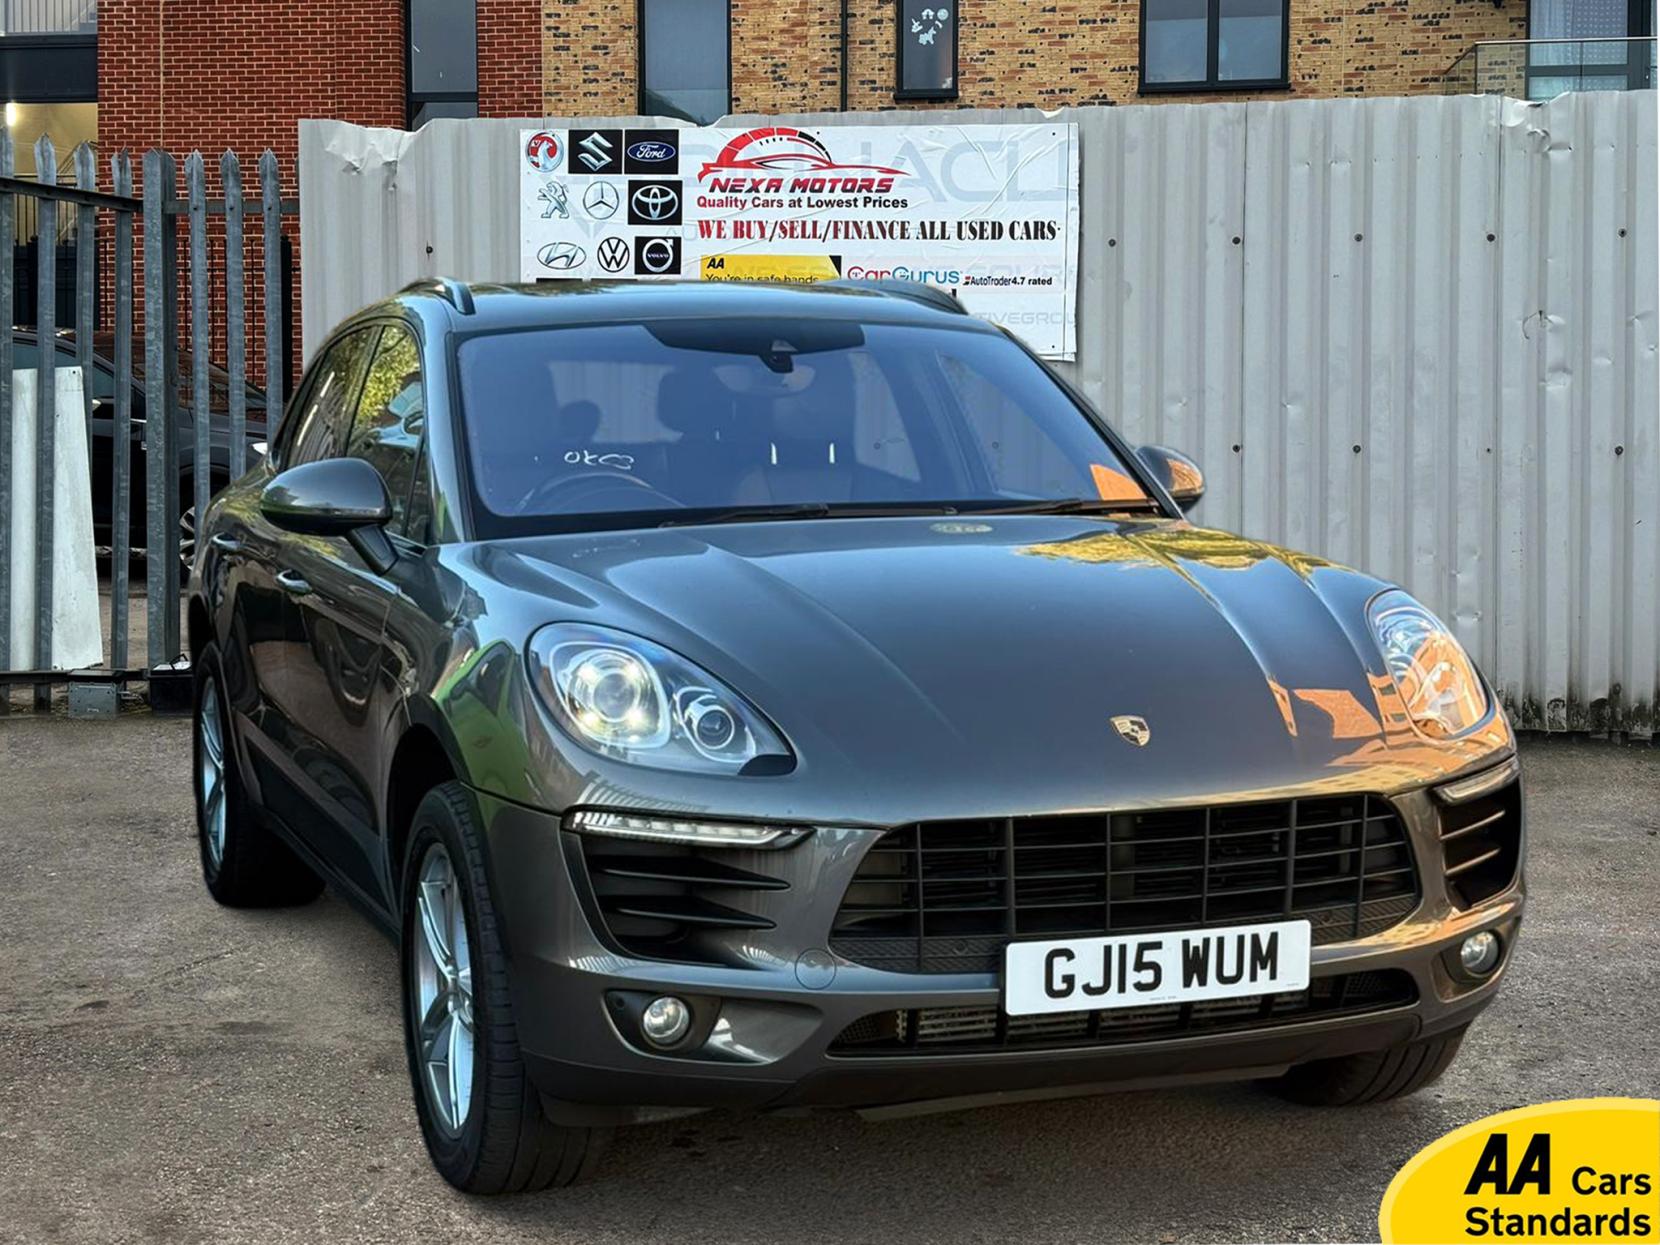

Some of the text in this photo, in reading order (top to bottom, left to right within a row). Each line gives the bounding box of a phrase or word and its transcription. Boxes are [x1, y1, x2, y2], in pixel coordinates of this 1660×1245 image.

[636, 144, 666, 159] Ford
[709, 177, 895, 194] NEXA MOTORS
[697, 195, 908, 211] Quality Cars at Lowest Prices
[697, 219, 727, 240] WE
[916, 220, 951, 241] ALL
[956, 220, 1004, 241] USED
[1008, 220, 1057, 241] CARS
[706, 257, 725, 269] AA
[847, 265, 960, 284] CarGurus
[1028, 276, 1053, 286] rated
[1044, 931, 1279, 999] GJ15 WUM
